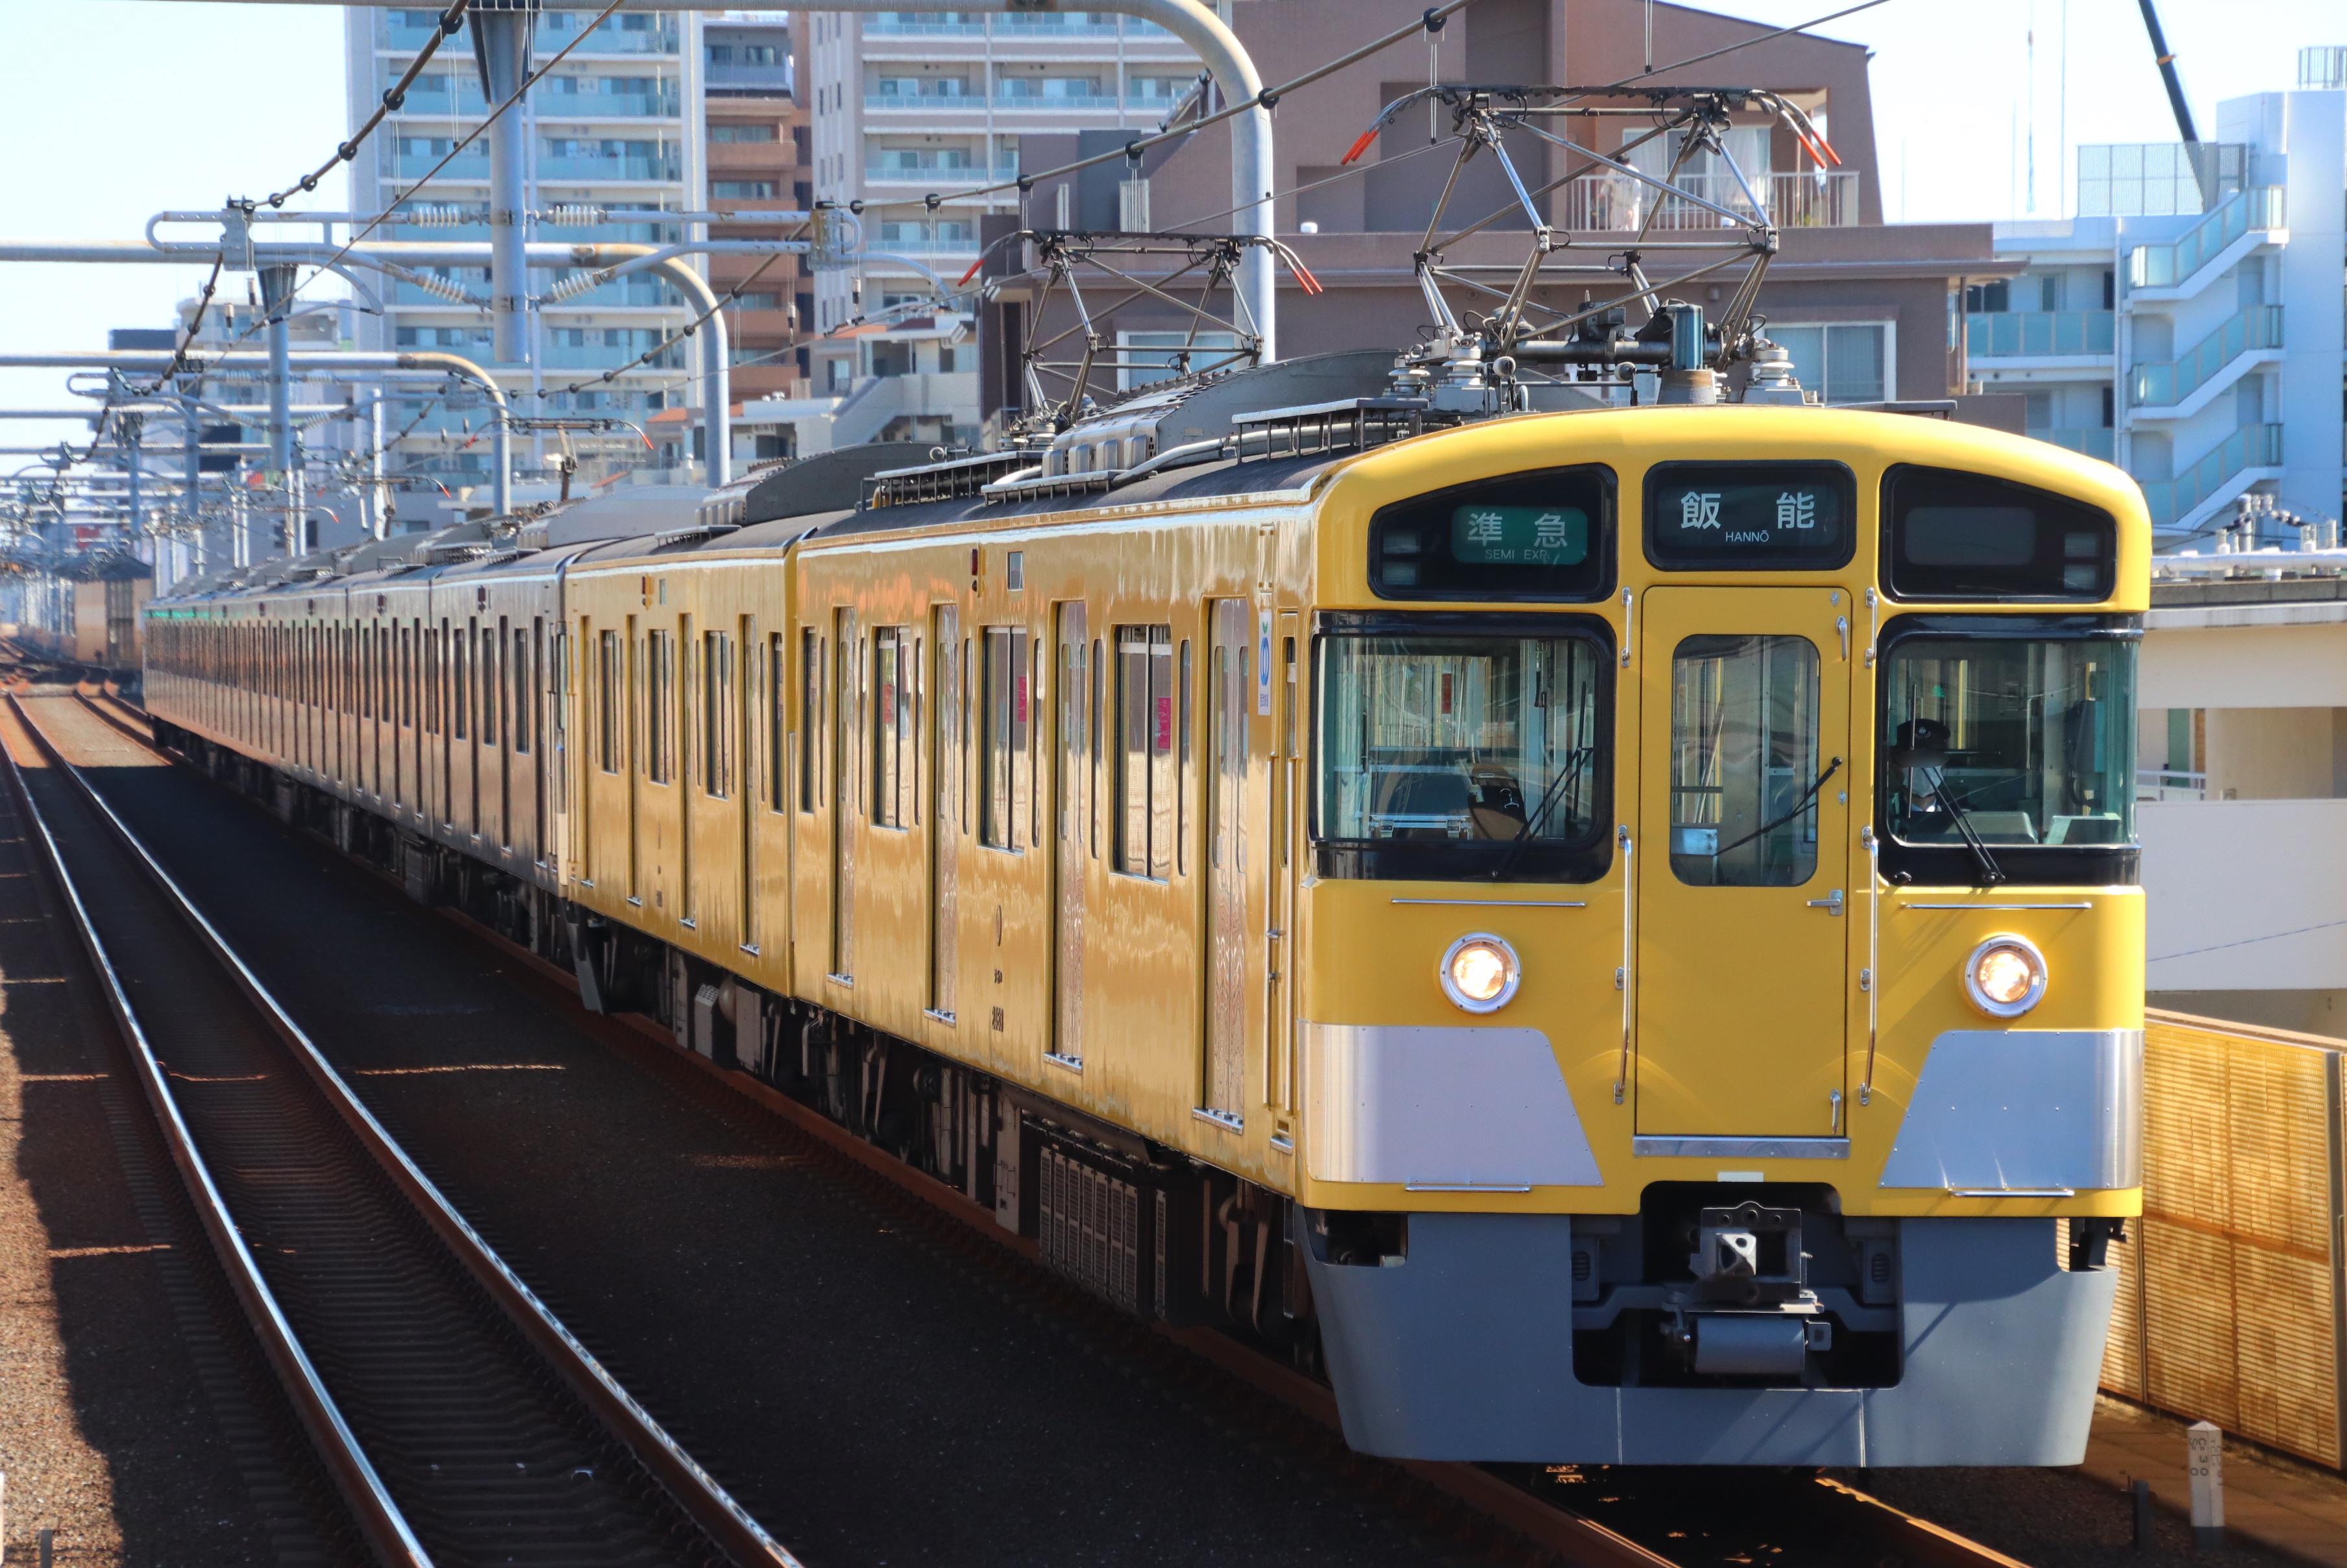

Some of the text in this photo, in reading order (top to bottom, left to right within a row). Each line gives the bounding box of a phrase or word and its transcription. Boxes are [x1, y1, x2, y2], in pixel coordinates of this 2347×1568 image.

[1680, 491, 1815, 530] 飯能
[1467, 512, 1568, 548] 準急
[1484, 549, 1515, 560] SEMI
